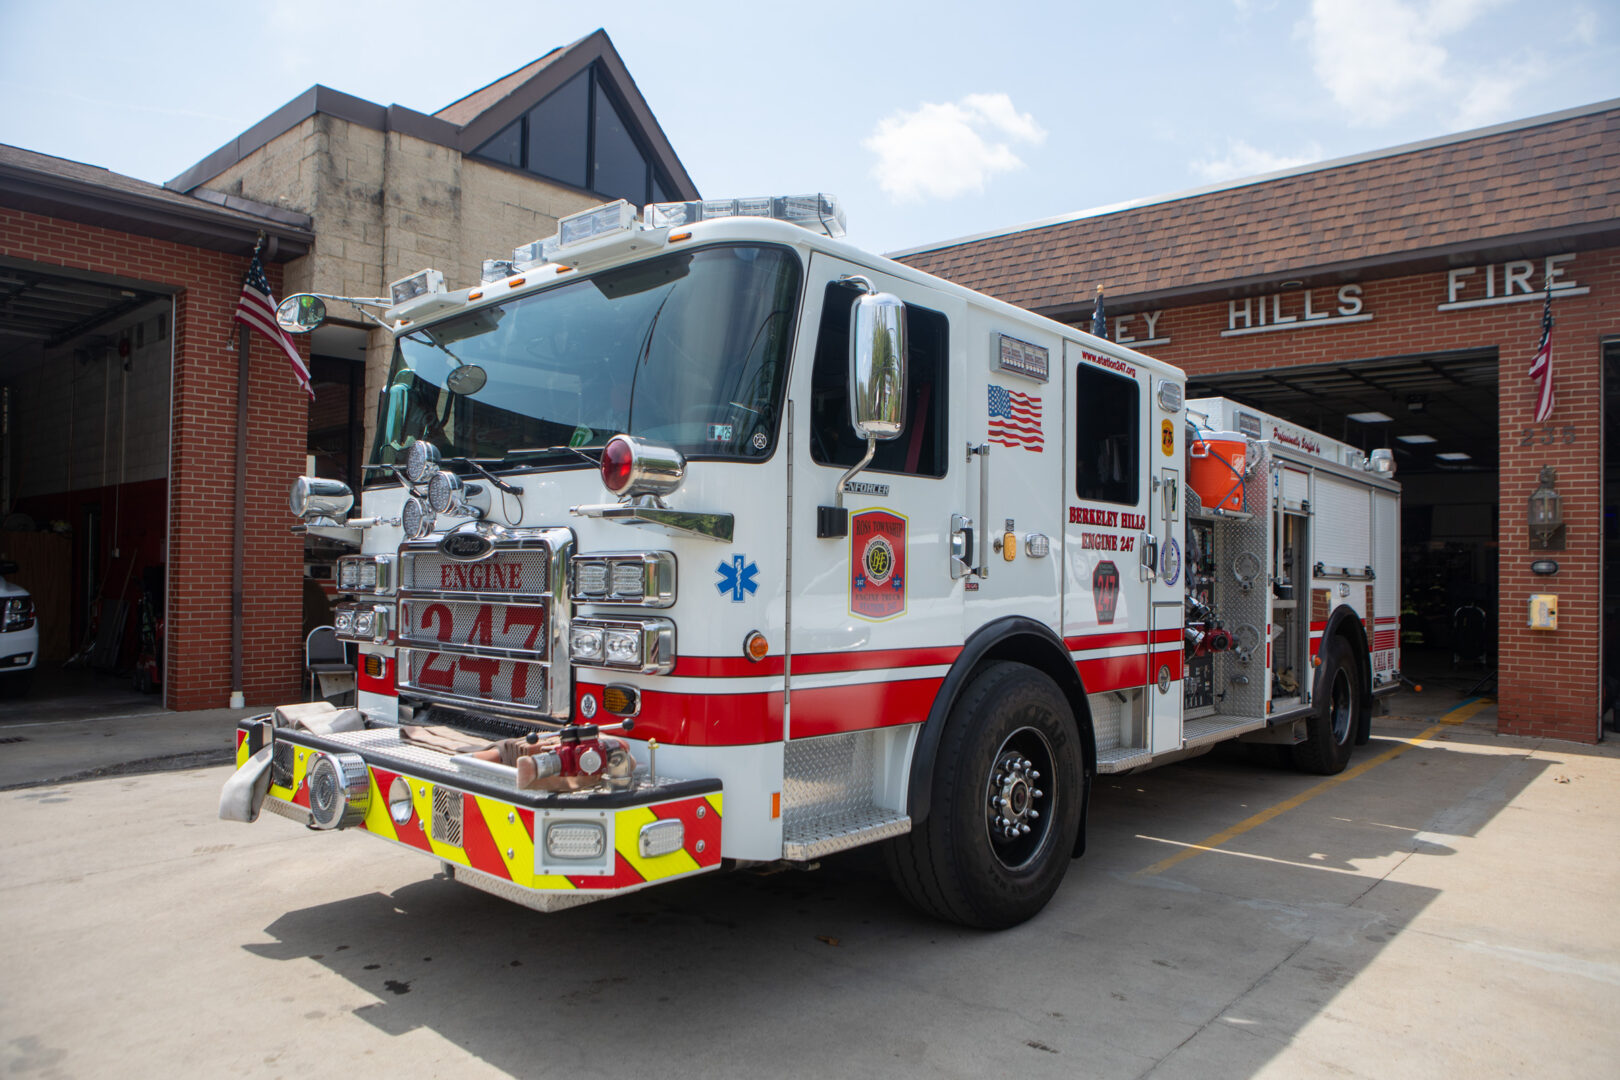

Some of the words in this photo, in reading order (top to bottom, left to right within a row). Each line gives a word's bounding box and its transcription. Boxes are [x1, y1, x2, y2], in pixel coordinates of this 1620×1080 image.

[1228, 284, 1363, 330] HILLS
[1448, 253, 1577, 303] FIRE
[1081, 350, 1137, 378] www.station247.org
[1520, 425, 1577, 447] 235
[844, 482, 889, 495] ENFORCER
[855, 520, 872, 537] ROSS
[872, 520, 903, 538] TOWNSHIP
[1069, 506, 1119, 528] BERKELEY
[1120, 512, 1146, 531] HILLS
[1081, 532, 1118, 551] ENGINE
[1119, 536, 1135, 553] 247
[440, 563, 523, 589] ENGINE
[1097, 575, 1116, 612] 247
[418, 603, 544, 700] 247
